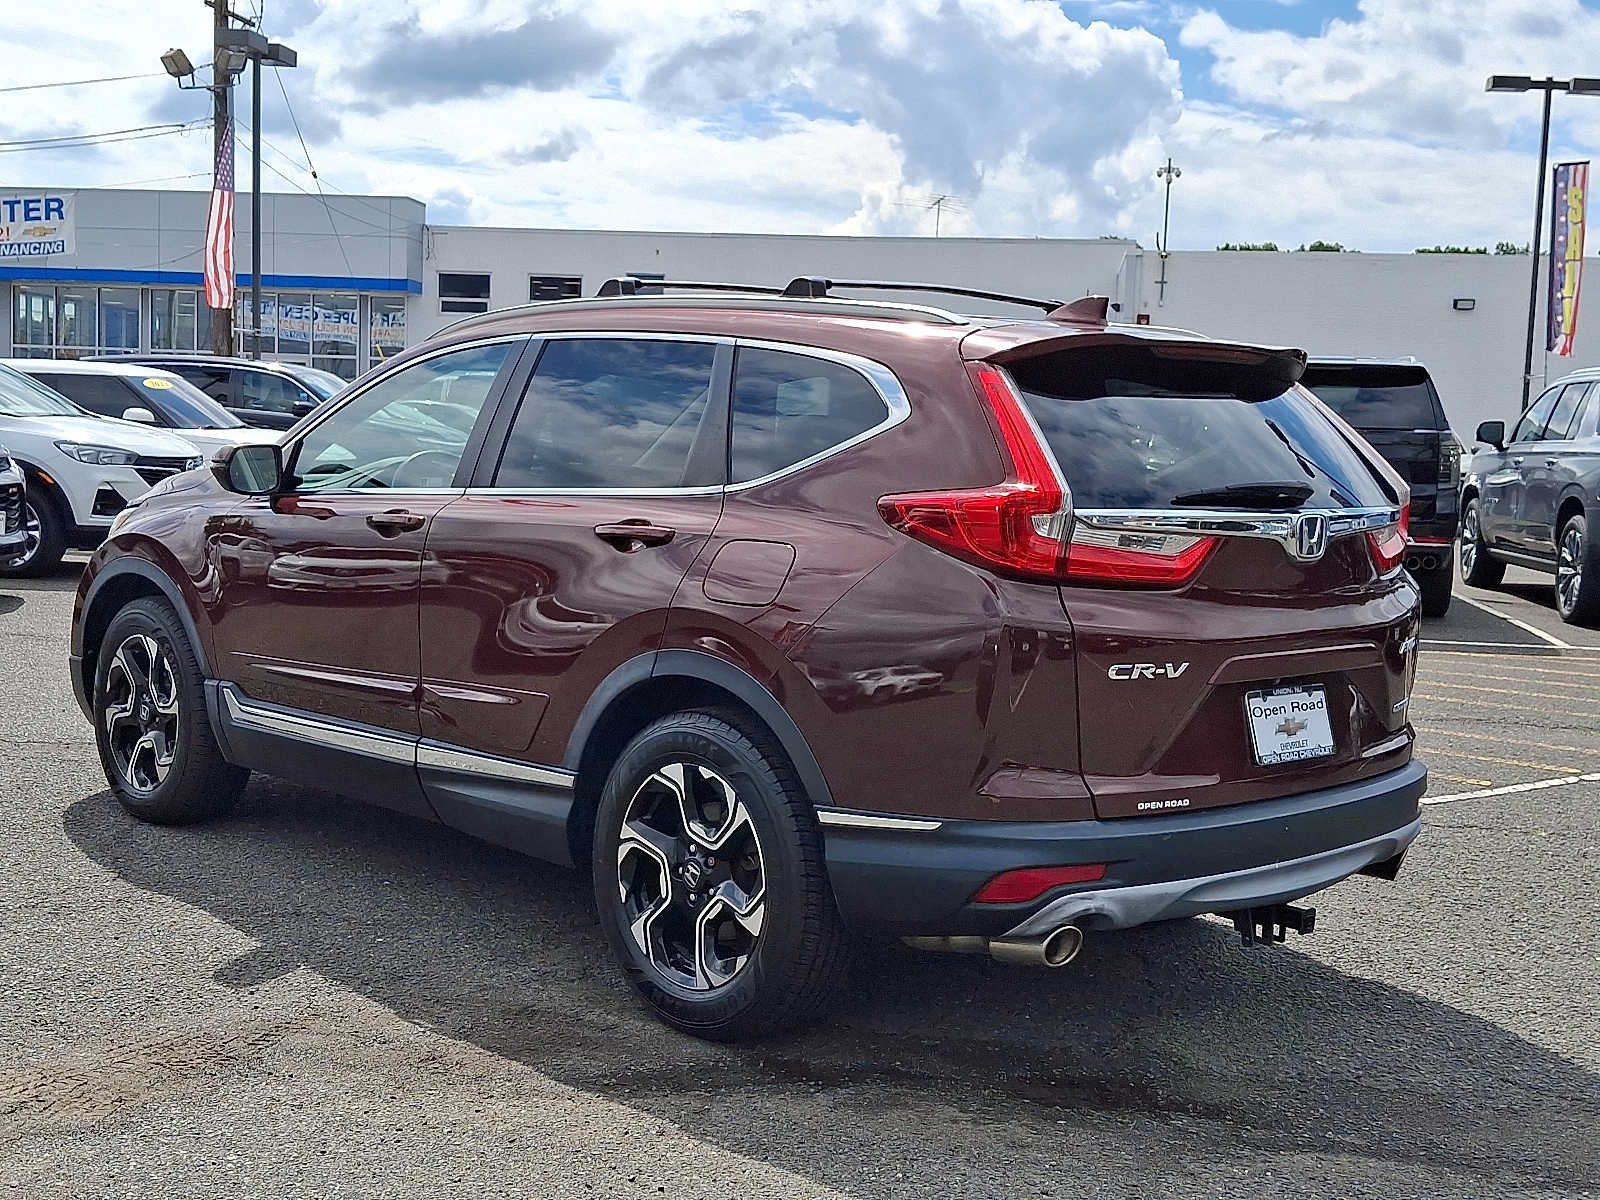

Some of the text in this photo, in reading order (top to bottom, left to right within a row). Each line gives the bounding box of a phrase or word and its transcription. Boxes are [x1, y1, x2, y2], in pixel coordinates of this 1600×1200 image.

[0, 198, 65, 222] TER
[1108, 662, 1190, 680] CR-V
[1252, 698, 1325, 719] Open Road
[1137, 799, 1190, 810] OPEN ROAD
